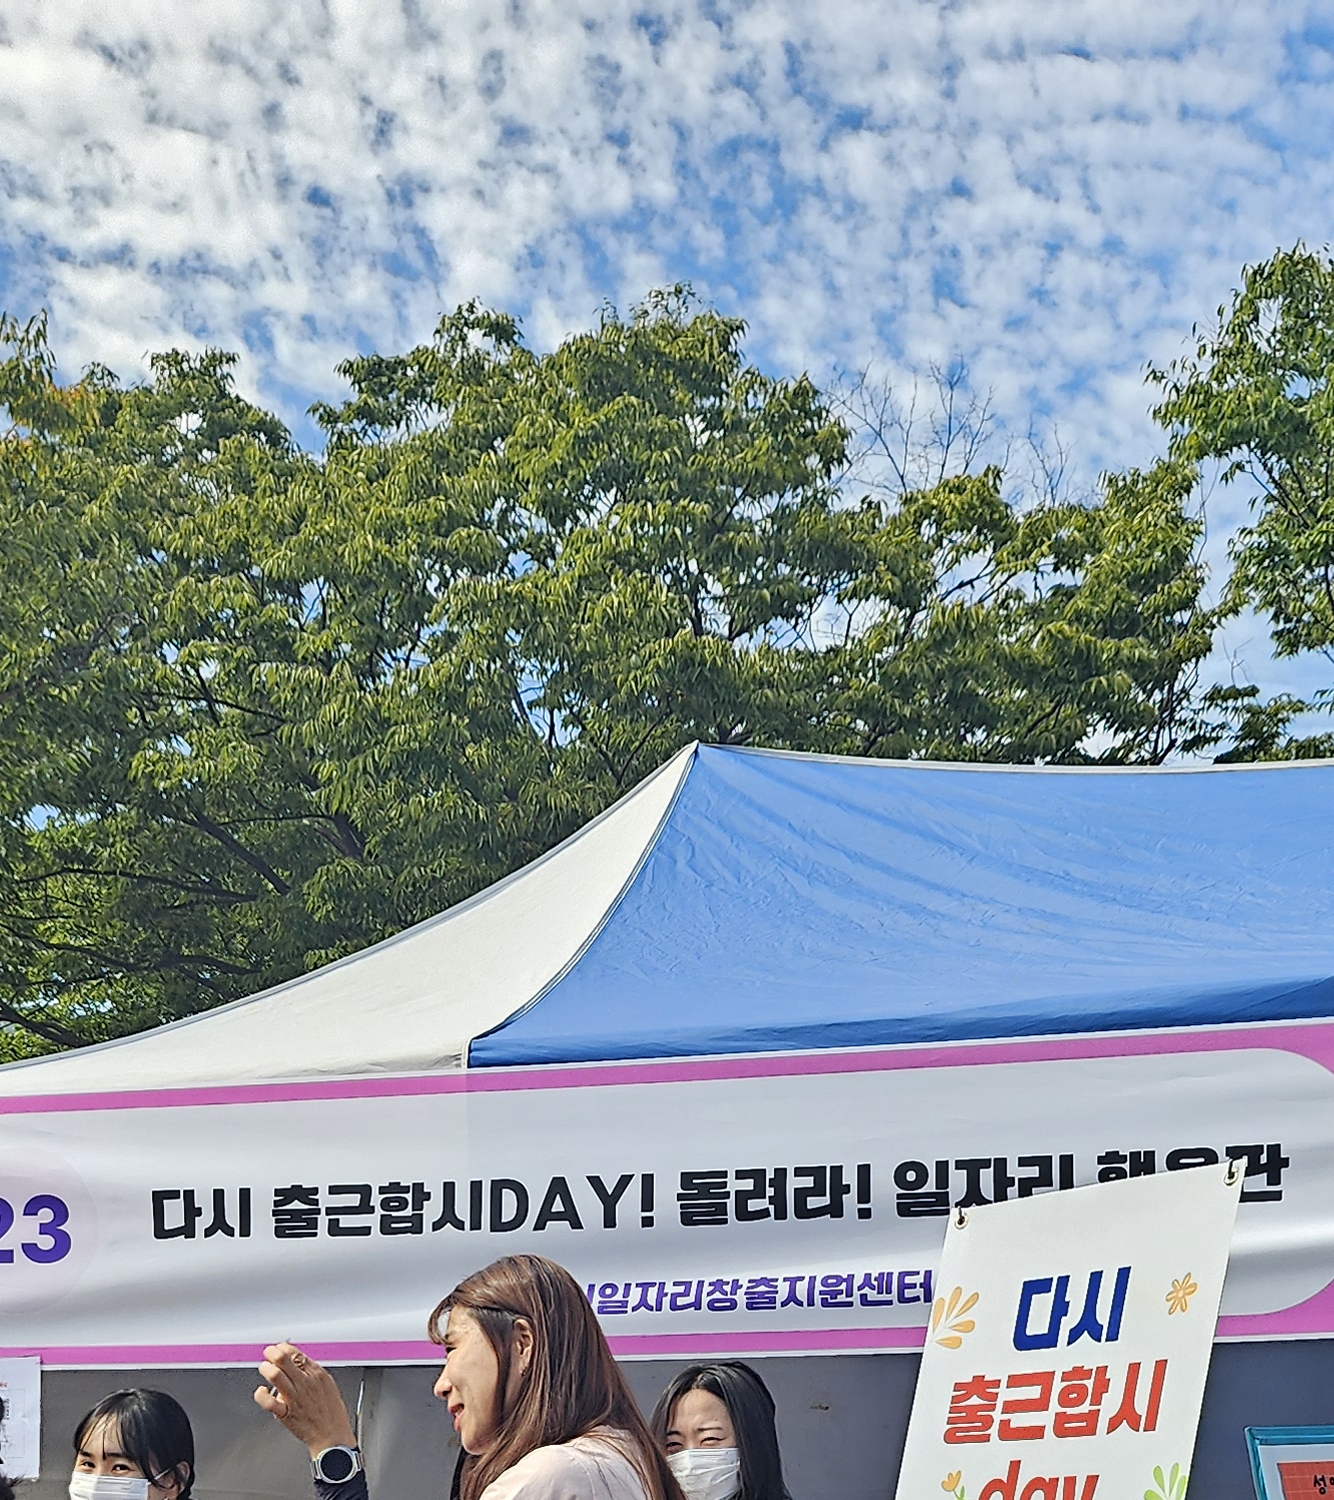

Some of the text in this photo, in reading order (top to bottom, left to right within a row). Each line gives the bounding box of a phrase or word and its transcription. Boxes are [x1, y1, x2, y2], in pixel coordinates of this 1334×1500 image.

[152, 1143, 1290, 1242] 다시 출근합시DAY! 돌려라! 일자리 행판
[586, 1269, 934, 1315] 일자리창출지원센터
[1013, 1266, 1132, 1351] 다시
[943, 1359, 1168, 1444] 출근합시
